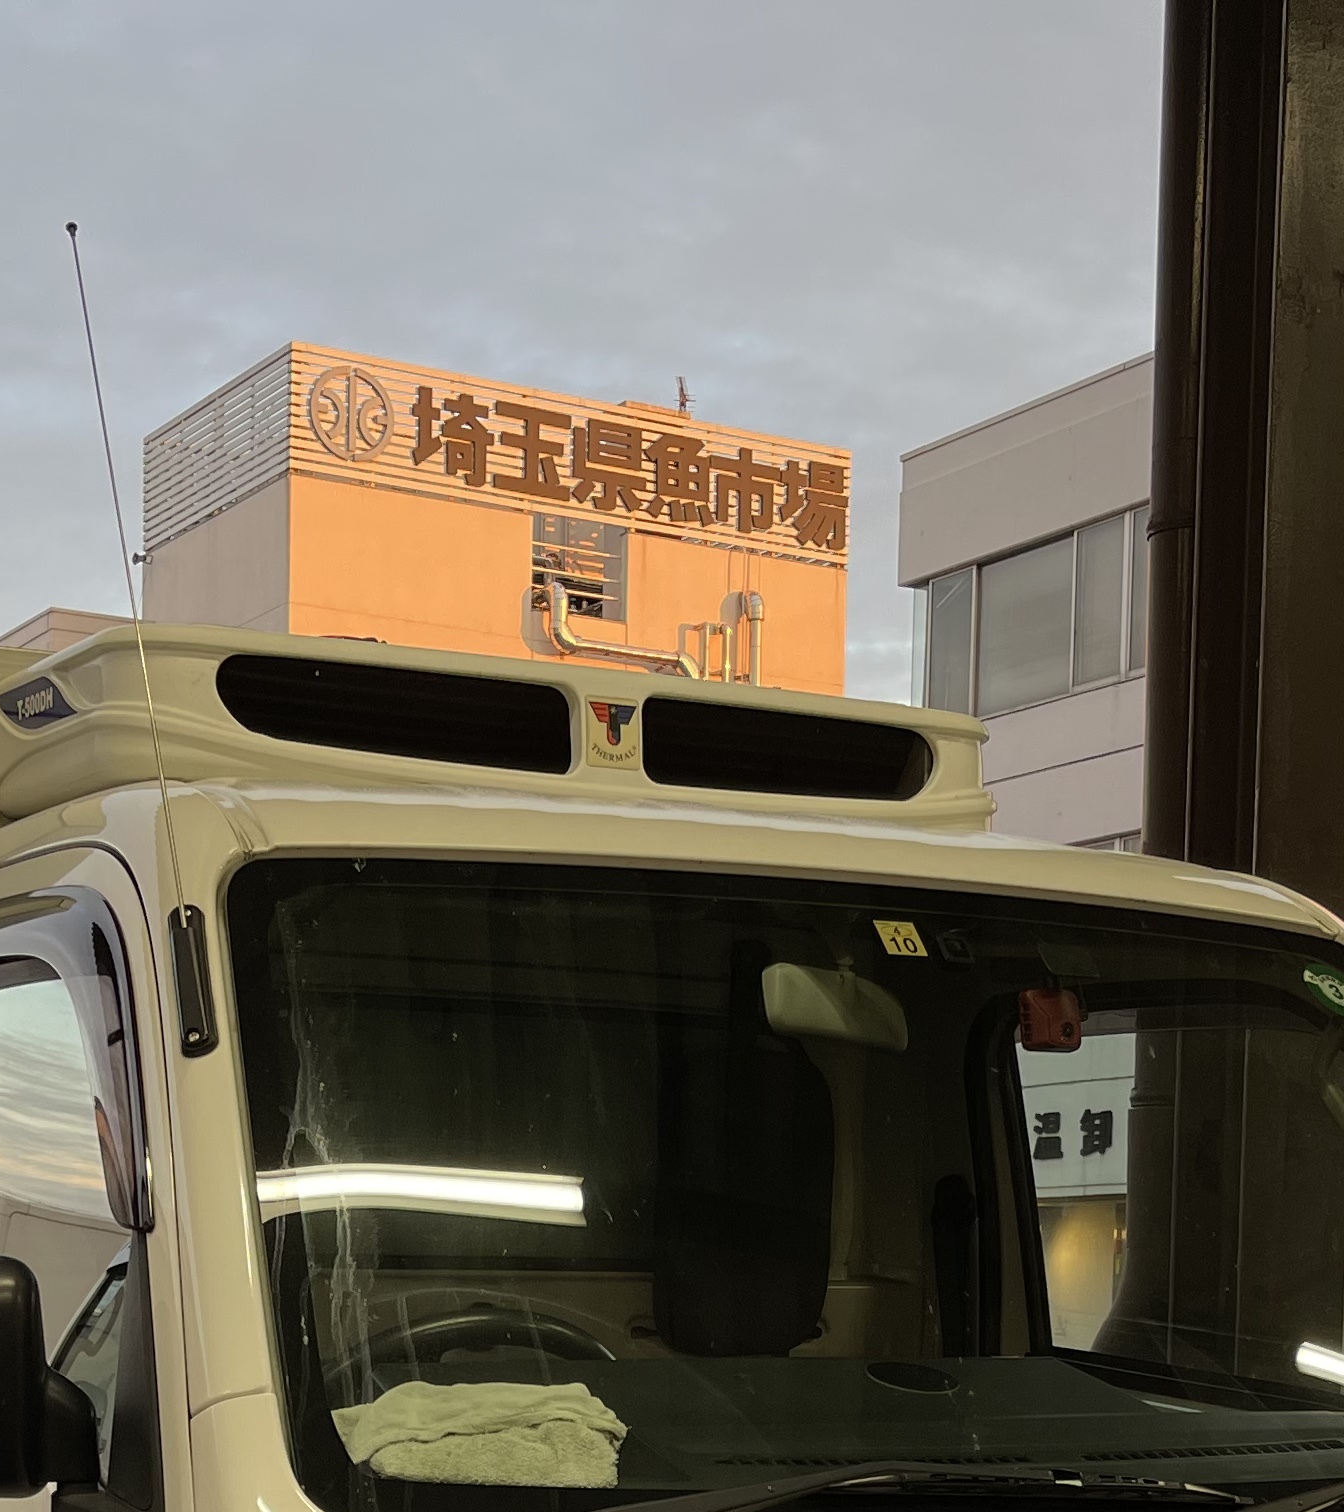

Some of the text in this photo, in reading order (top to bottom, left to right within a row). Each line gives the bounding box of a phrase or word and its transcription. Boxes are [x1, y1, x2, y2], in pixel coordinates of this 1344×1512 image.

[412, 386, 850, 550] 埼玉県魚市場
[889, 937, 918, 954] 10
